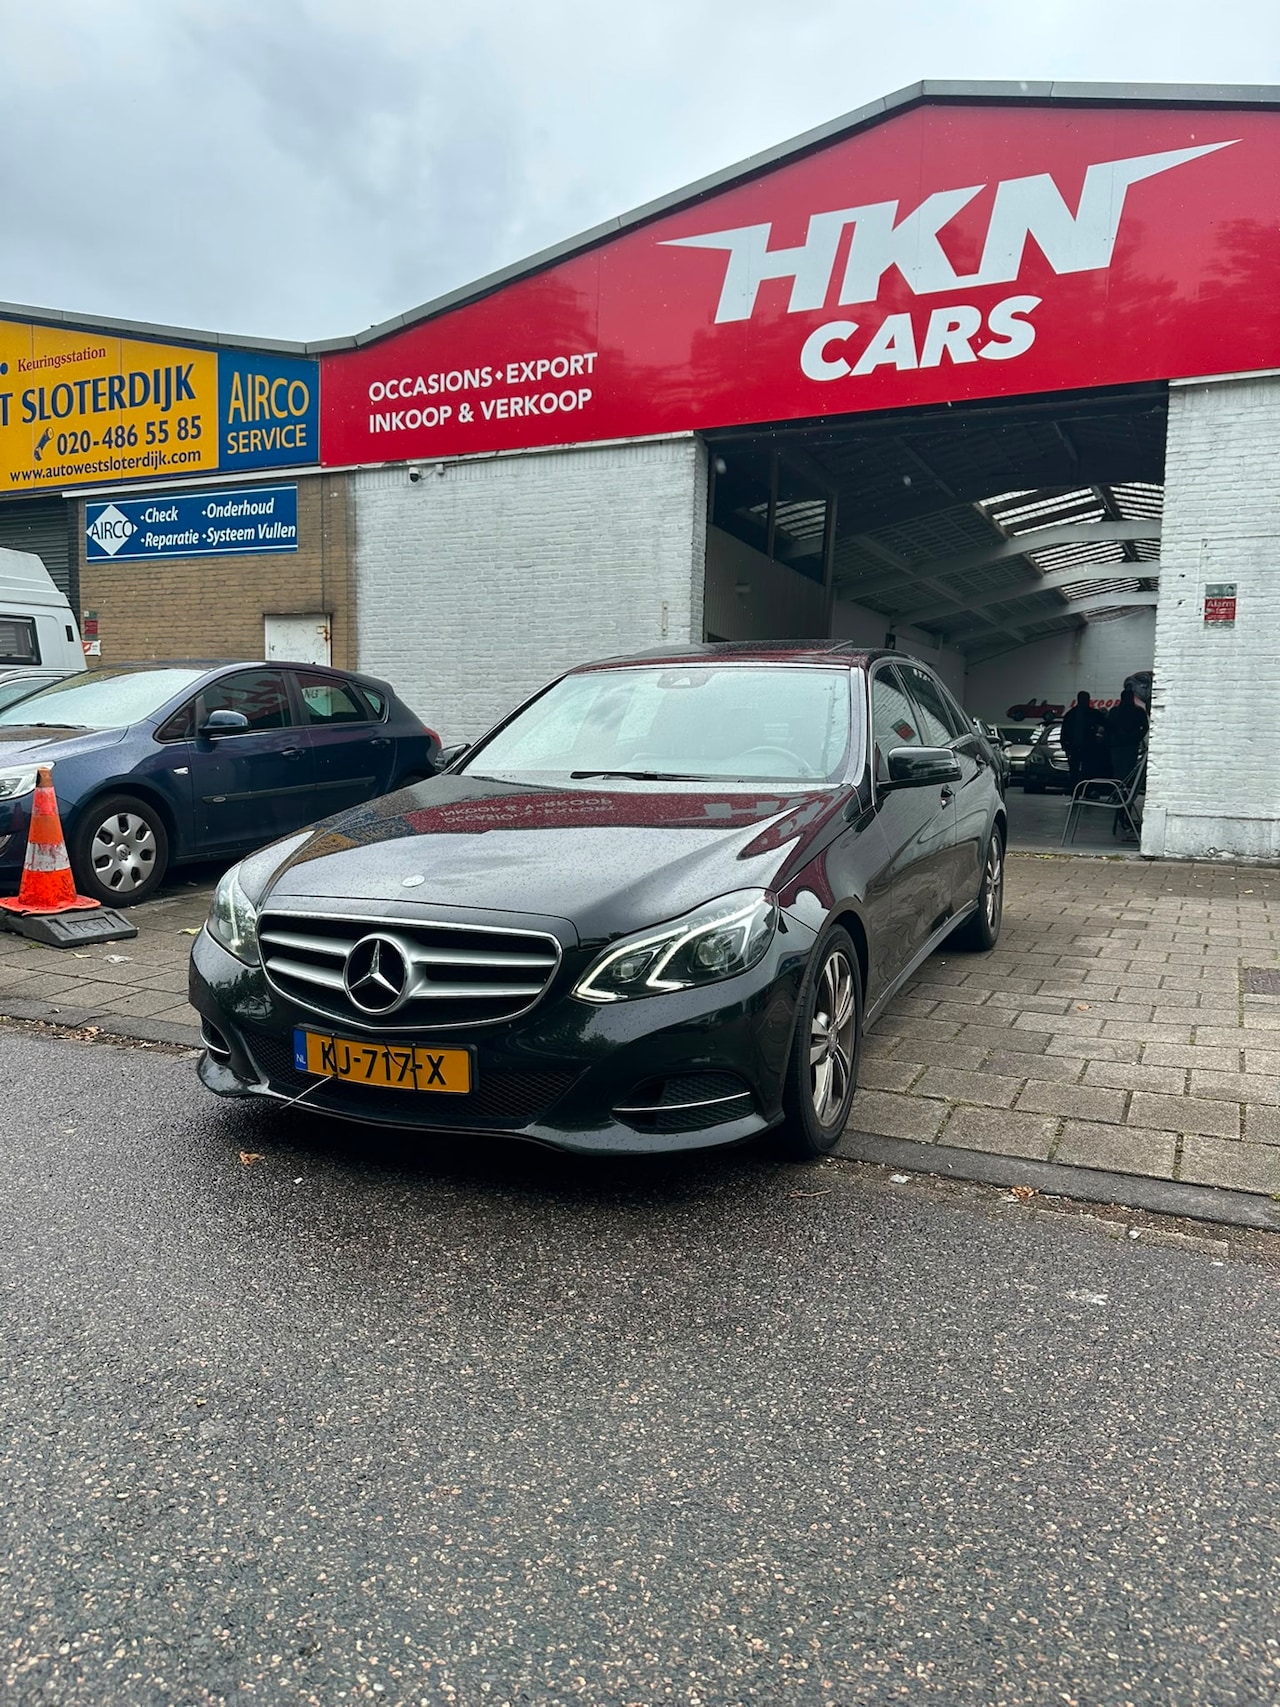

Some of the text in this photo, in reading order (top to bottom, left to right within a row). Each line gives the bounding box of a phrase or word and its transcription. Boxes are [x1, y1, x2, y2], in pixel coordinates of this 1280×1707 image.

[656, 139, 1243, 325] HKN
[801, 295, 1042, 381] CARS
[17, 347, 106, 372] Keuringsstation
[368, 352, 598, 401] OCCASIONS EXPORT
[22, 364, 196, 424] SLOTERDIJK
[228, 372, 309, 424] AIRCO
[369, 389, 592, 433] INKOOP & VERKOOP
[57, 415, 201, 455] 020-486 55 85
[227, 424, 307, 454] SERVICE
[10, 451, 201, 482] www.autowestsloterdijk.com
[91, 520, 133, 541] AIRCO
[258, 522, 296, 540] Vullen
[296, 1053, 307, 1065] NL
[321, 1041, 446, 1085] KJ-717-X
